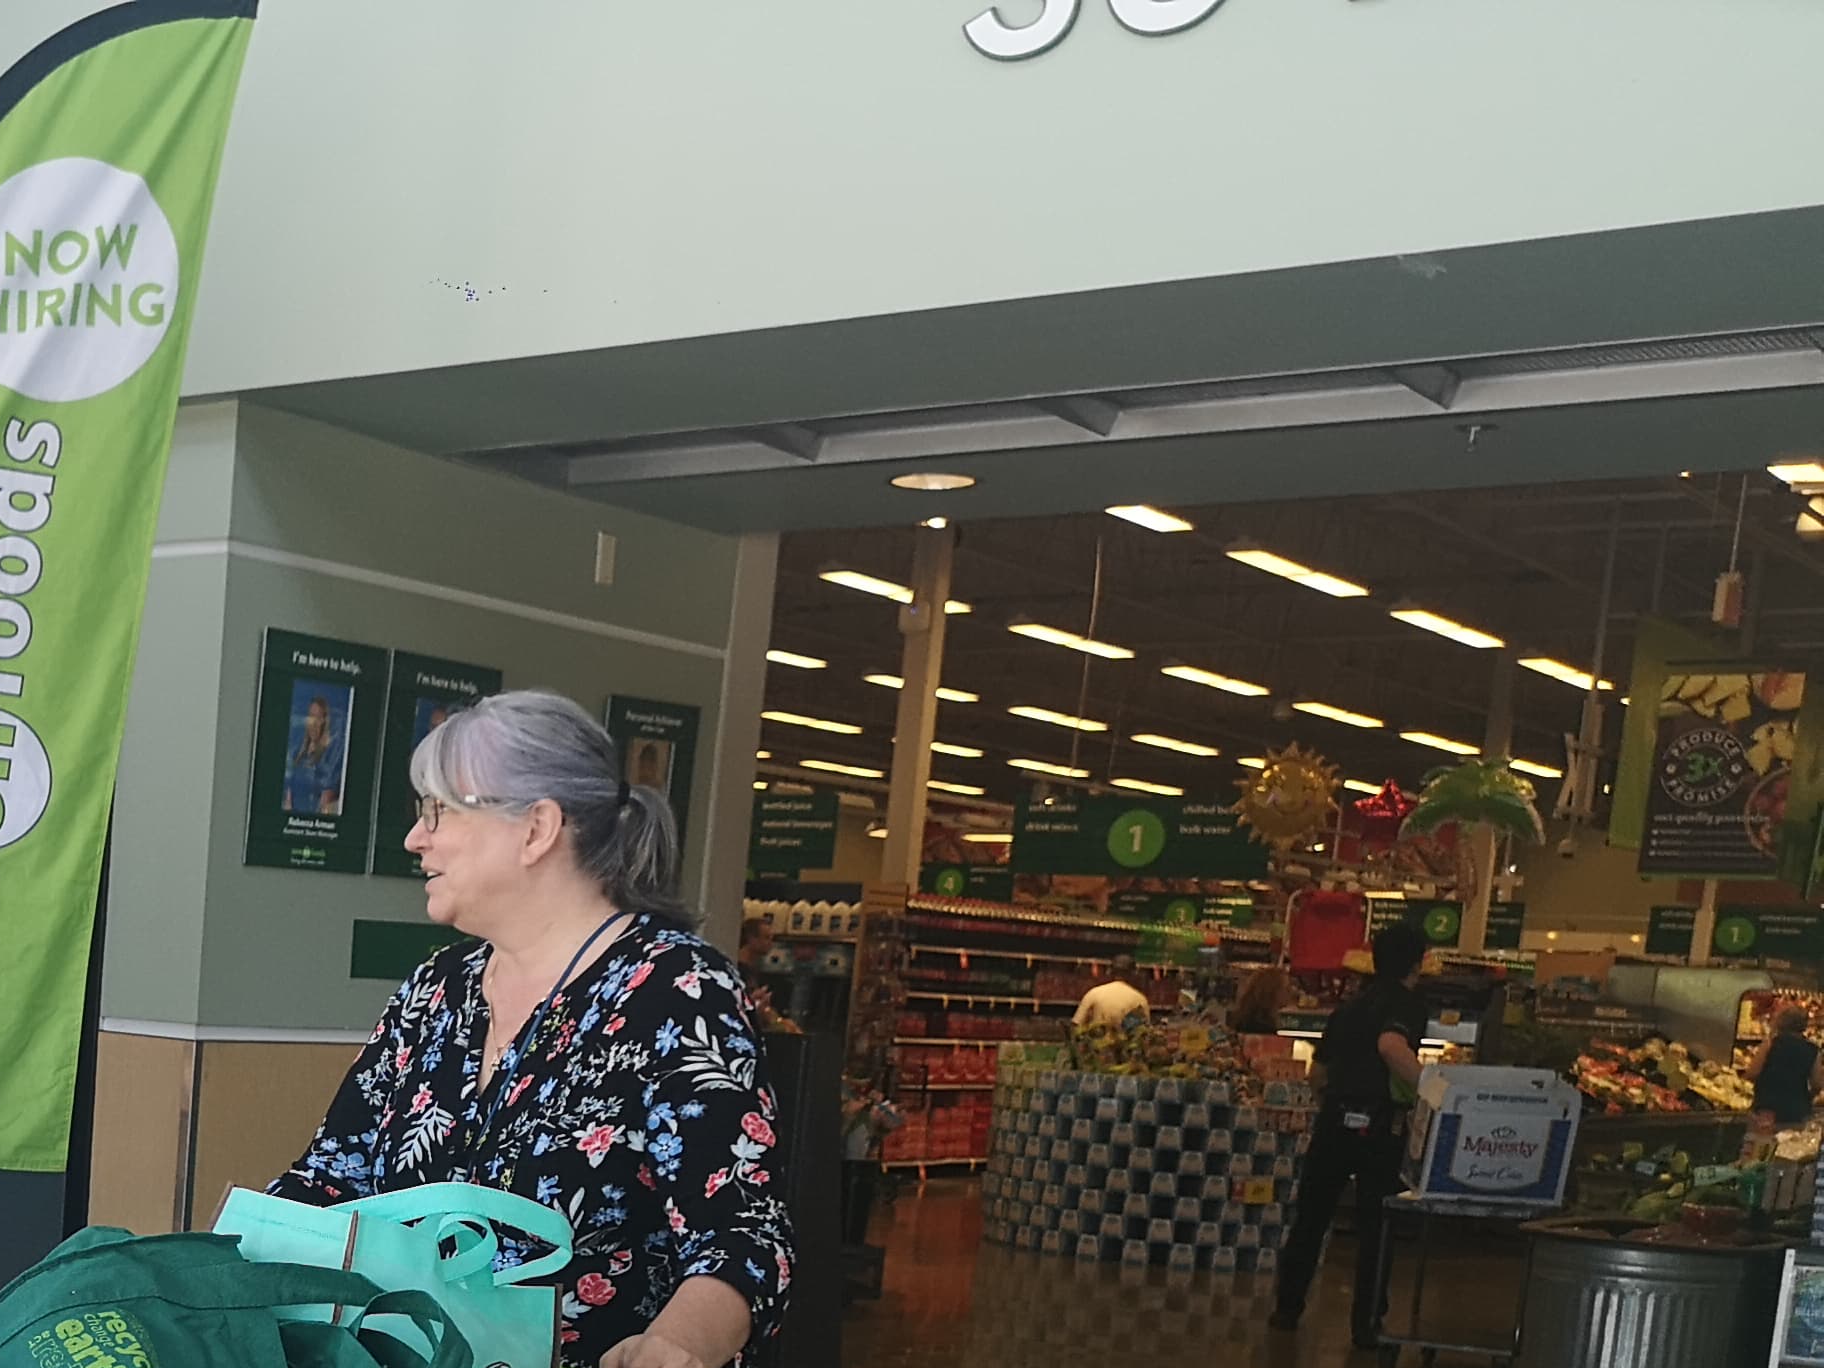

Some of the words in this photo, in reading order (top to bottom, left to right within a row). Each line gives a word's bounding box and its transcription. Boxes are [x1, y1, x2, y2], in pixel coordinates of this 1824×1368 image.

[4, 223, 138, 277] NOW
[308, 653, 328, 669] here
[330, 658, 339, 670] to
[430, 675, 448, 689] here
[450, 679, 459, 690] to
[1671, 730, 1742, 758] PRODUCE
[1667, 778, 1737, 802] PROMISE
[1129, 825, 1143, 852] 1
[945, 876, 954, 890] 4
[1435, 915, 1449, 932] 2
[84, 1313, 115, 1347] change
